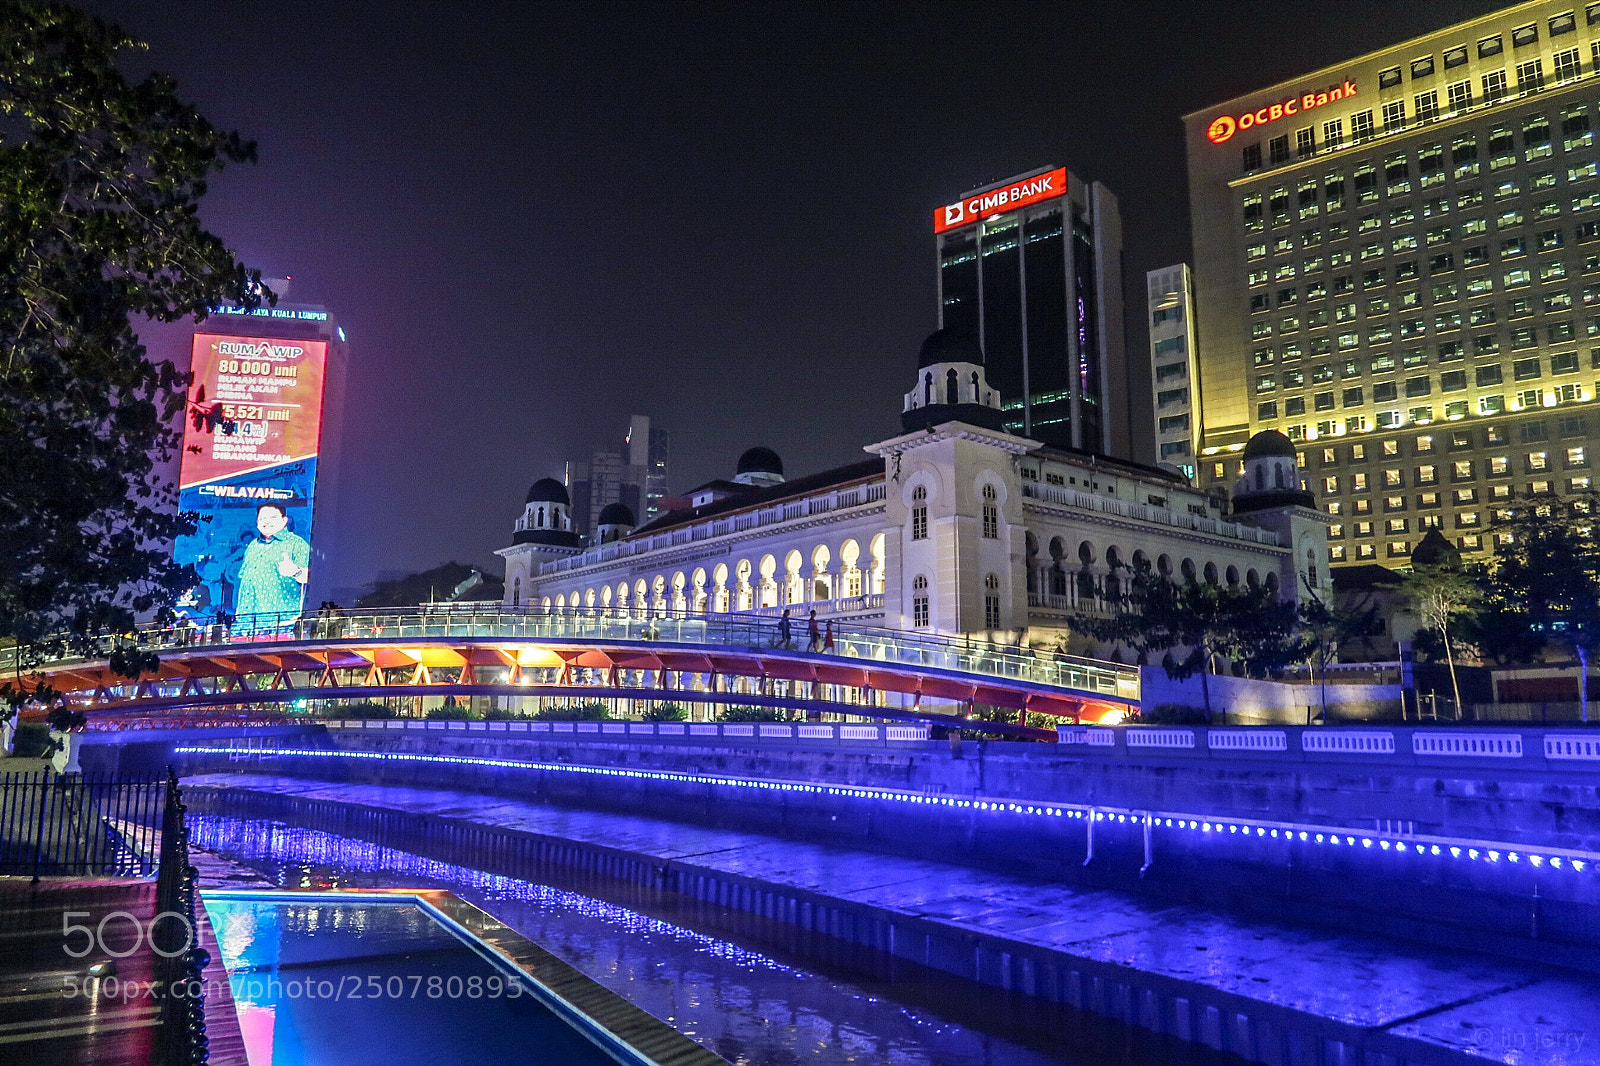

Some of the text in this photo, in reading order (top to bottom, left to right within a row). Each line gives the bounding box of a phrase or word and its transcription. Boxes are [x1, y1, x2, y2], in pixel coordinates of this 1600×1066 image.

[1238, 81, 1358, 130] OCBC Bank
[968, 176, 1053, 214] CIMB BANK
[271, 309, 296, 319] KUALA
[298, 311, 328, 321] LUMPUR
[274, 365, 297, 377] unit
[267, 409, 290, 421] unit
[214, 485, 275, 499] WILAYAH
